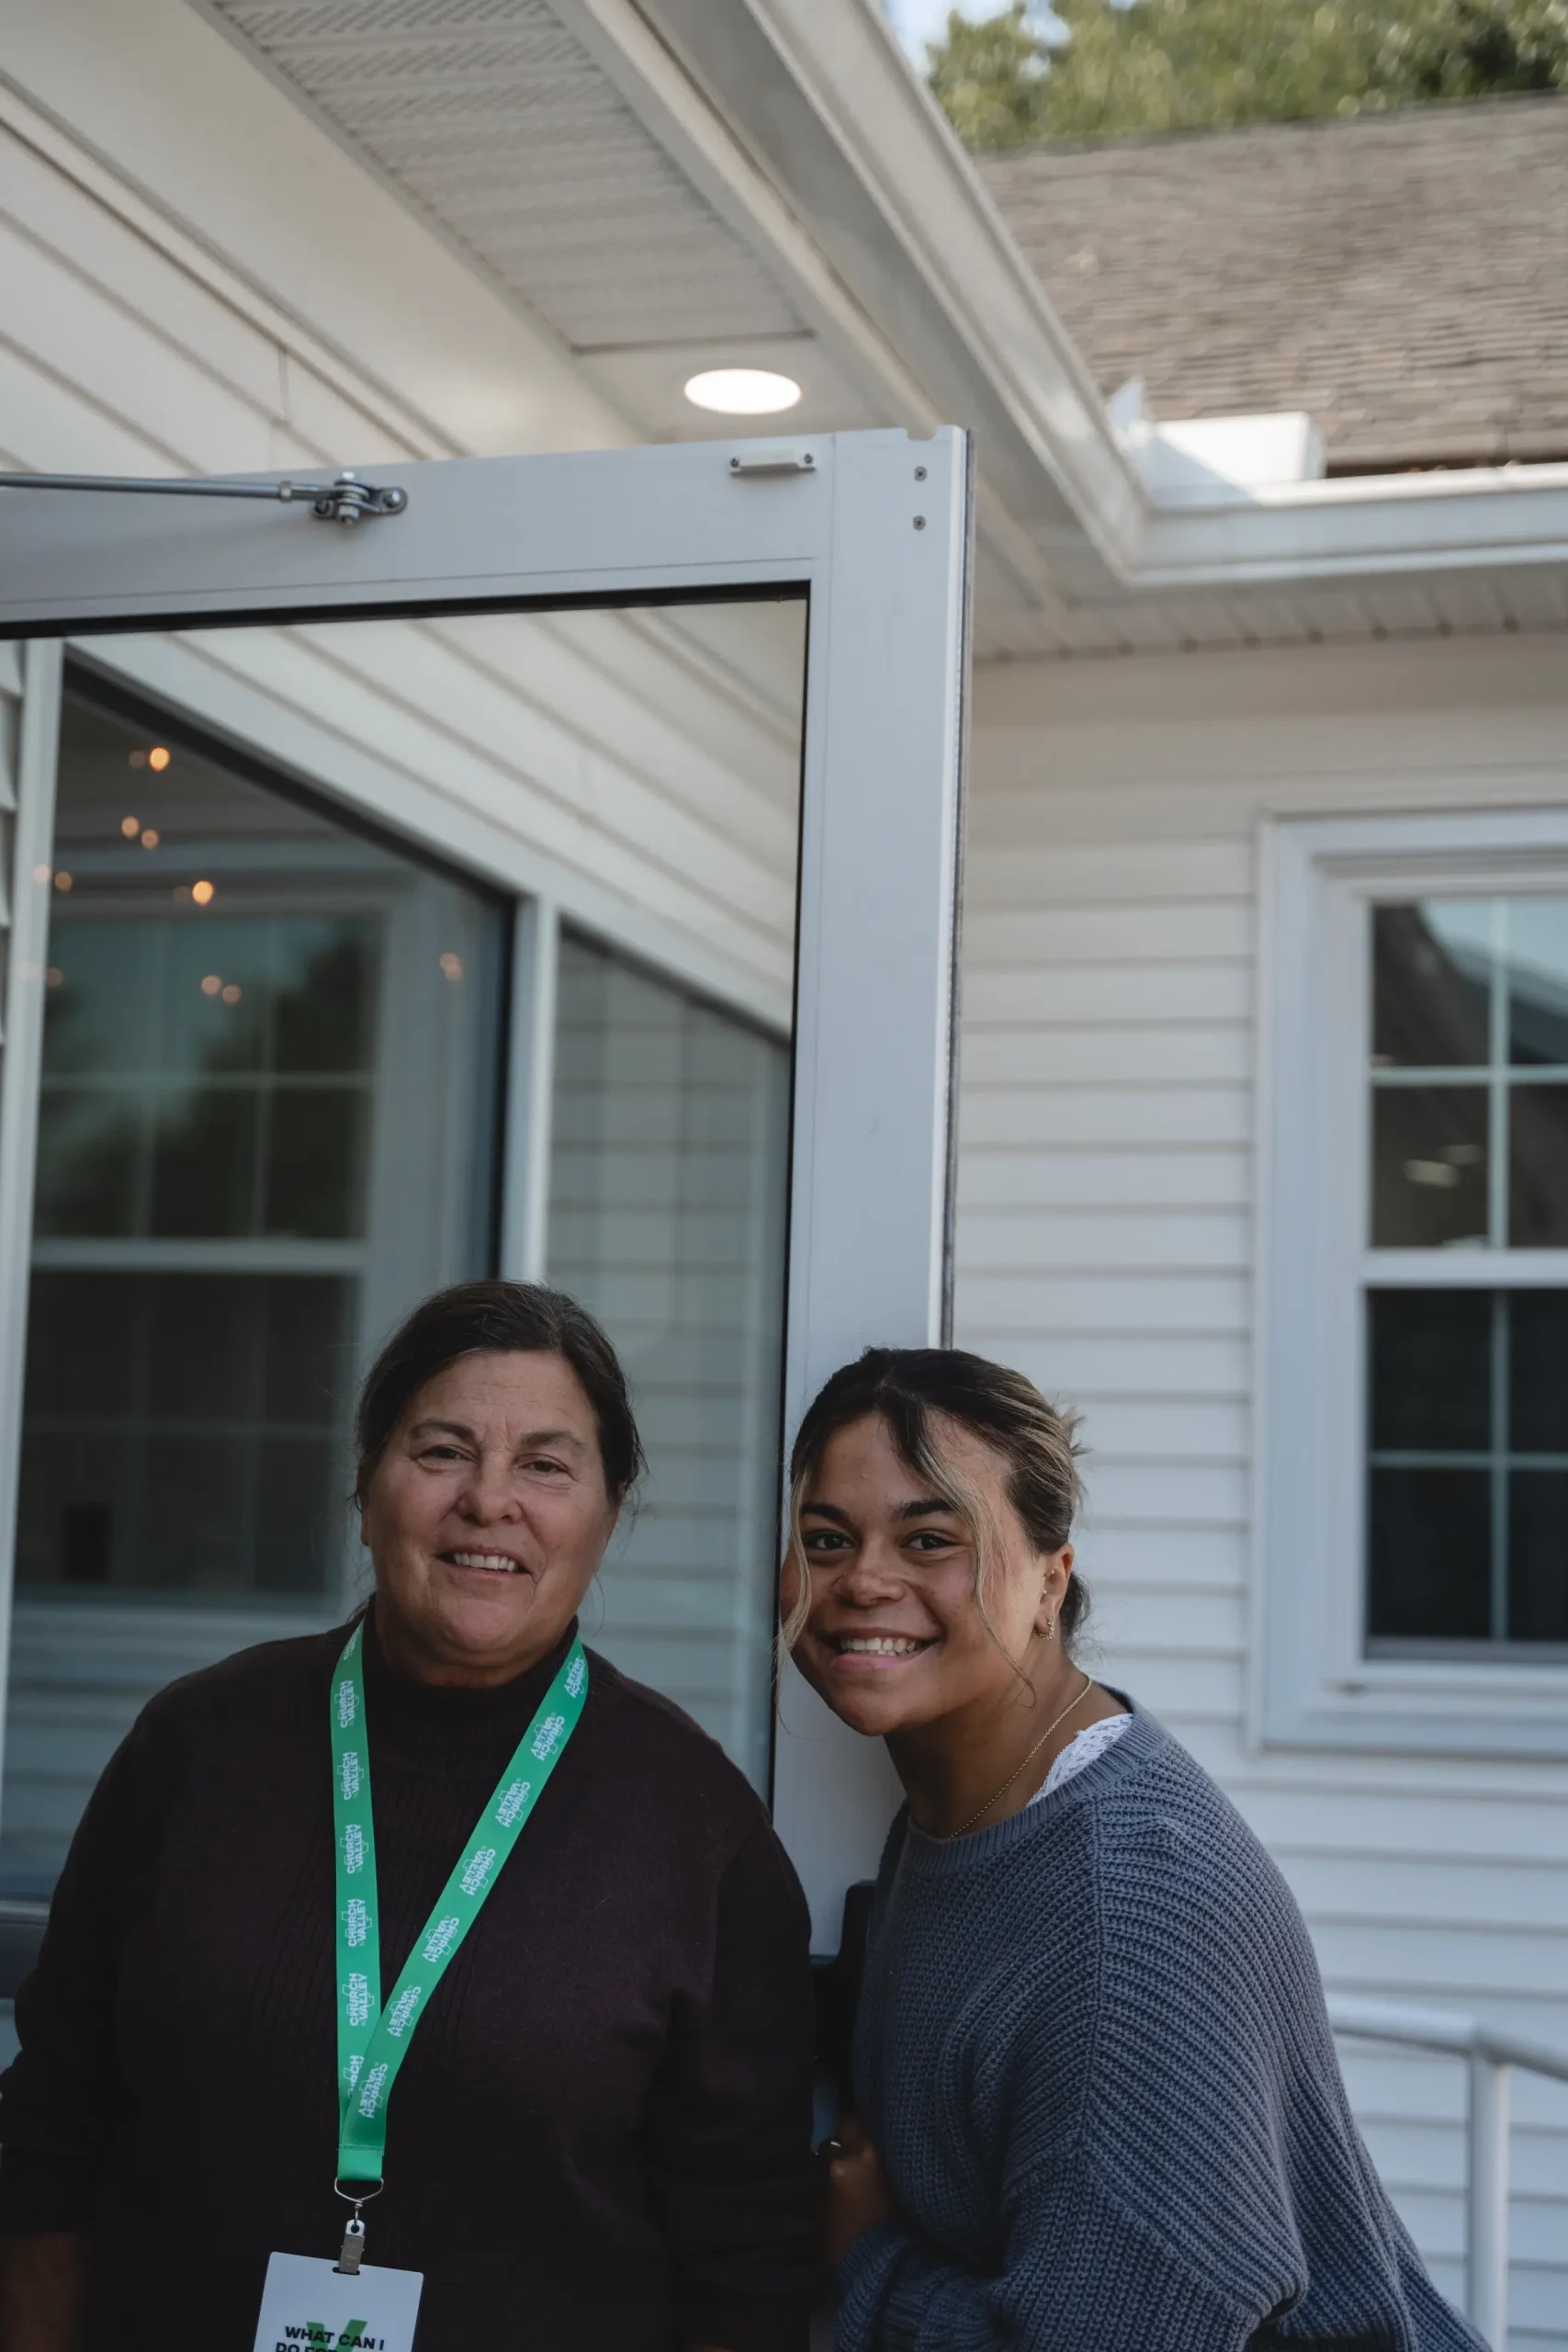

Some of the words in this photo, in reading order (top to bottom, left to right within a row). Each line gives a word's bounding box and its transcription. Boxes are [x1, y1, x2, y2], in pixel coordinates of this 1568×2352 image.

[340, 1680, 348, 1728] CHURCH
[346, 1680, 355, 1721] VALLEY
[530, 1716, 556, 1758] VALLEY
[537, 1715, 565, 1761] CHURCH
[343, 1753, 352, 1801] CHURCH
[350, 1752, 359, 1793] VALLEY
[495, 1782, 522, 1824] VALLEY
[502, 1781, 530, 1828] CHURCH
[345, 1825, 355, 1874] CHURCH
[354, 1824, 363, 1867] VALLEY
[459, 1850, 487, 1893] VALLEY
[467, 1849, 495, 1895] CHURCH
[347, 1899, 356, 1947] CHURCH
[356, 1899, 366, 1941] VALLEY
[423, 1919, 450, 1960] VALLEY
[429, 1917, 459, 1962] CHURCH
[349, 1973, 358, 2026] CHURCH
[358, 1973, 367, 2020] VALLEY
[387, 1990, 412, 2034] VALLEY
[393, 1986, 422, 2037] CHURCH
[358, 2067, 379, 2117] VALLEY
[366, 2063, 388, 2118] CHURCH
[285, 2325, 335, 2344] WHAT
[338, 2334, 376, 2350] CAN
[378, 2339, 385, 2351] I
